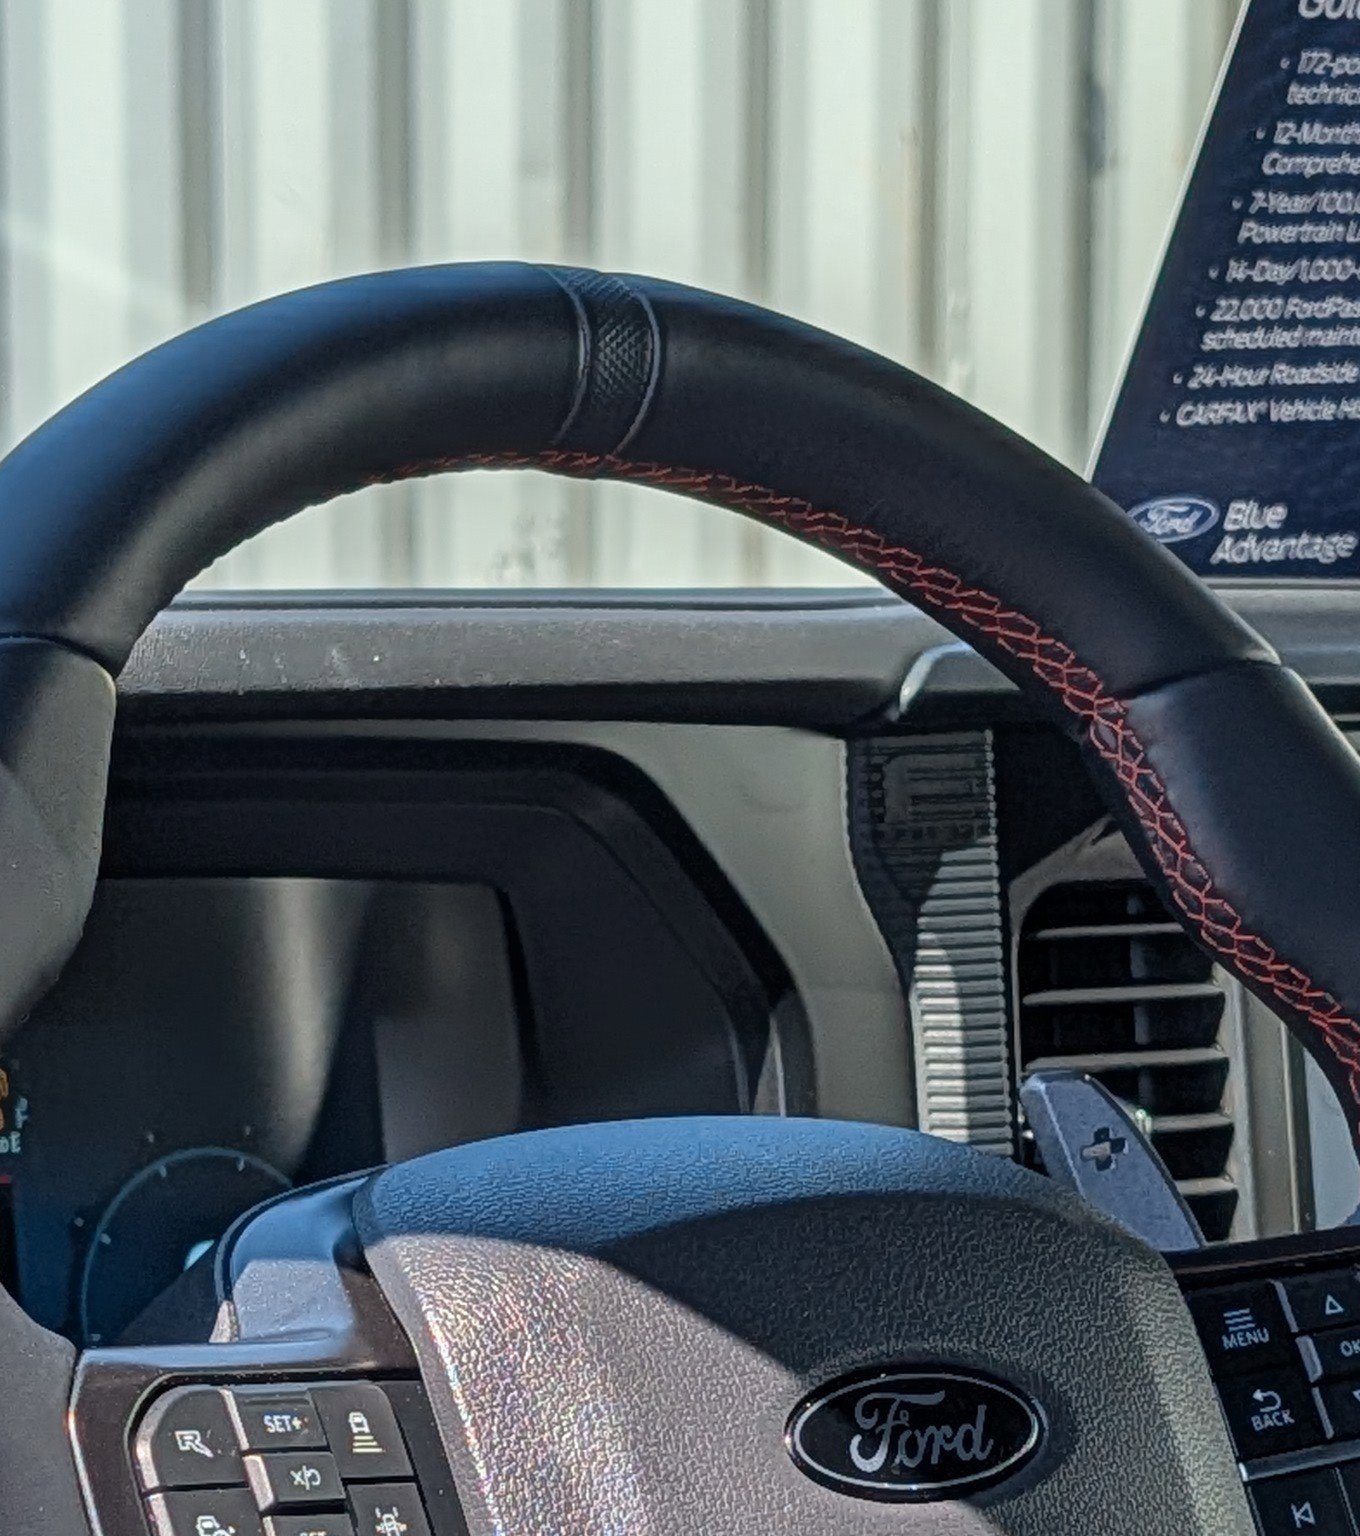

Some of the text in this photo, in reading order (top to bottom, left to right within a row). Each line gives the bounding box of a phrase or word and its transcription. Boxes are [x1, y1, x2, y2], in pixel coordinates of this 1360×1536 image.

[1238, 218, 1346, 244] Powertrain
[1202, 323, 1304, 351] scheduled
[1270, 360, 1359, 385] Roadside
[1269, 396, 1338, 423] Vehicle
[1140, 500, 1289, 535] Ford Blue
[1209, 531, 1359, 565] Advantage
[1222, 1327, 1270, 1351] MENU
[849, 1390, 994, 1473] Ford
[1251, 1408, 1296, 1432] BACK
